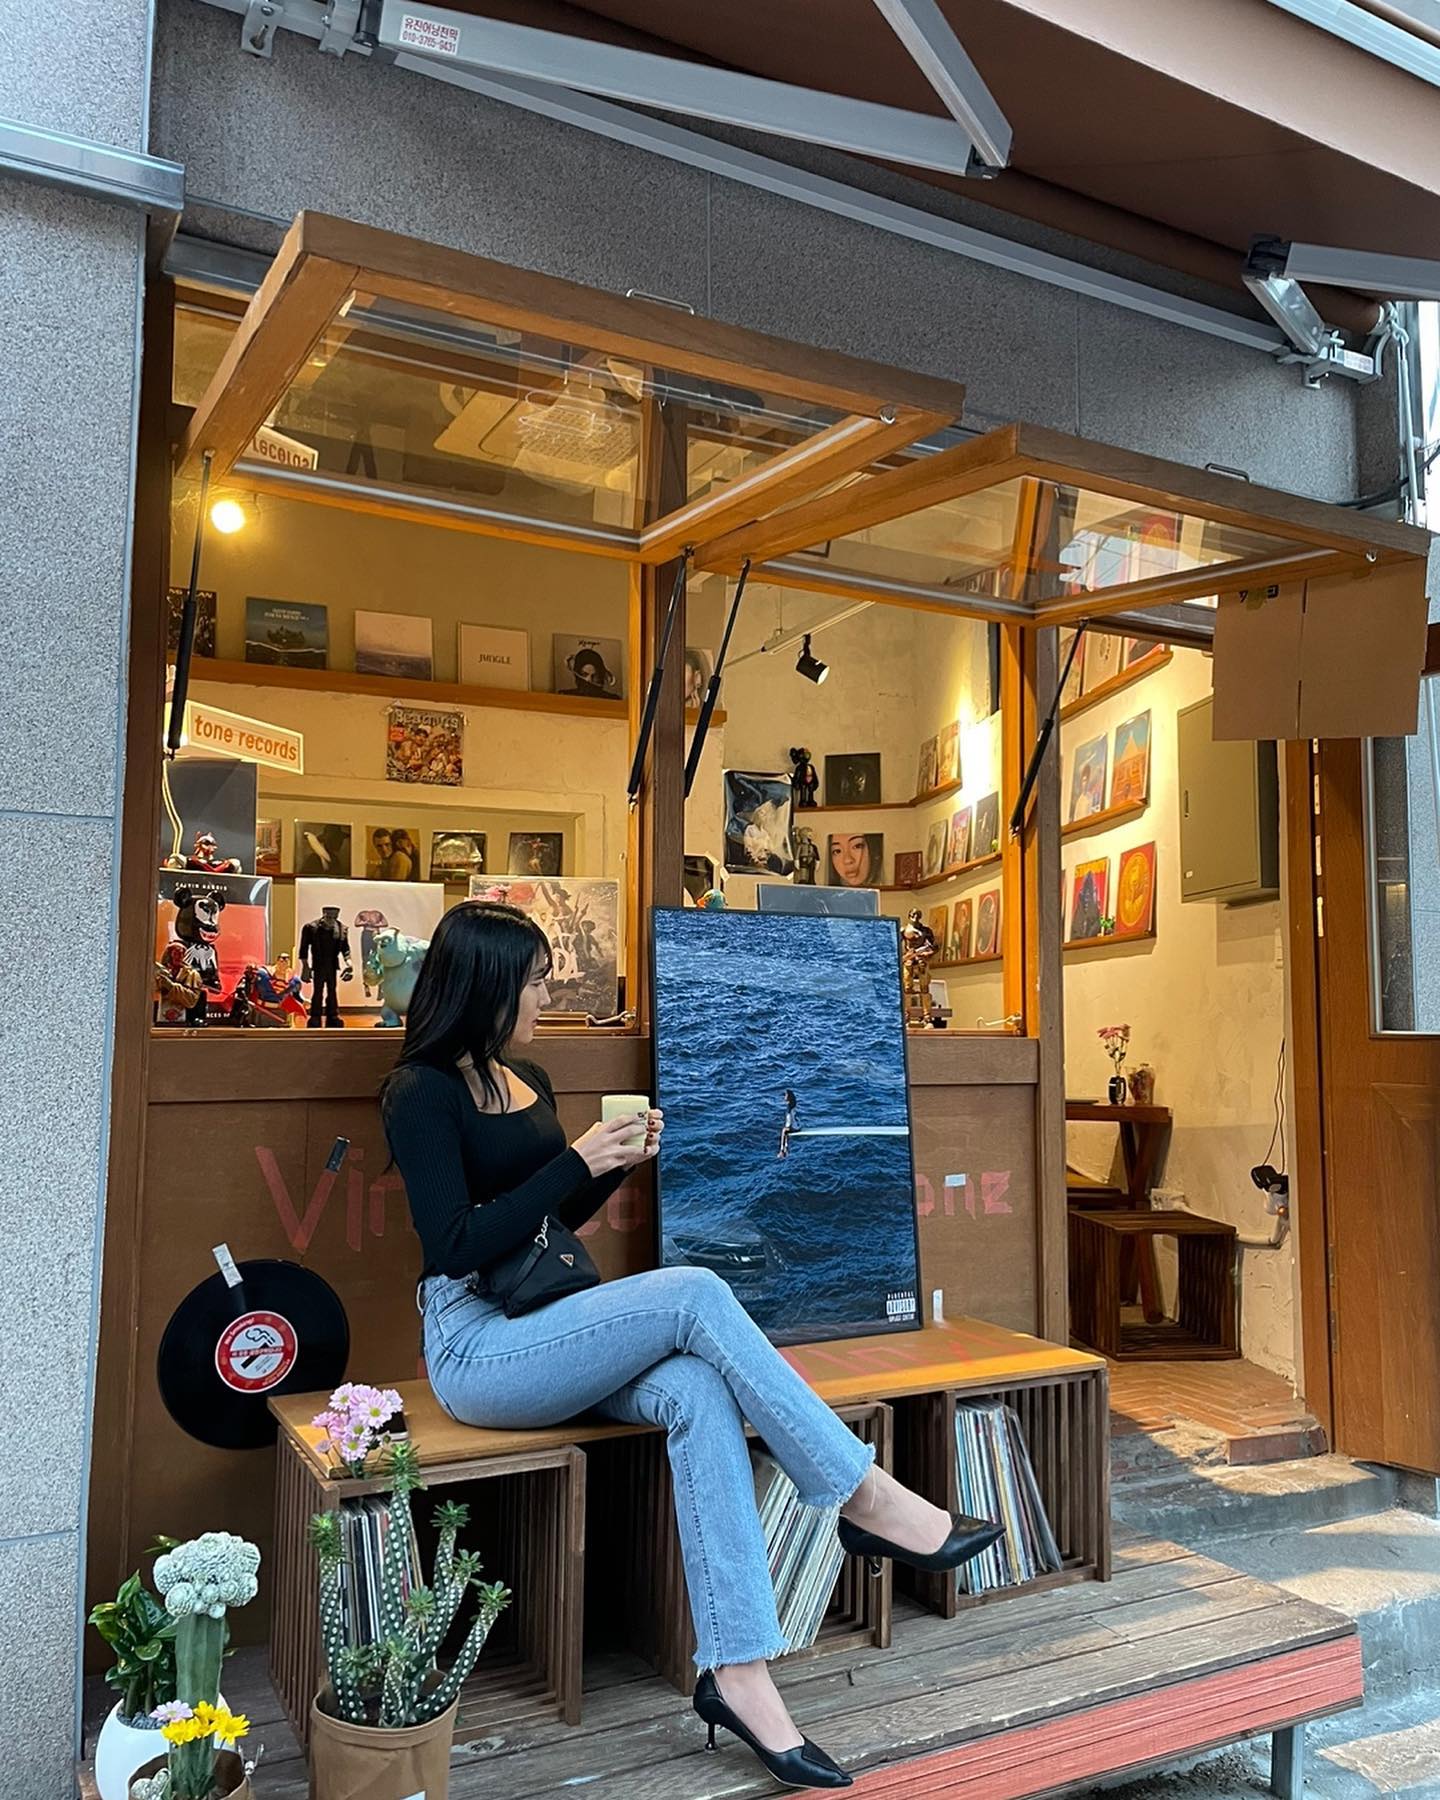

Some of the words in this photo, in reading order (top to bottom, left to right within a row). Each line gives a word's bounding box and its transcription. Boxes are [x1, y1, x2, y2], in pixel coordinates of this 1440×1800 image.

[478, 653, 512, 665] JUNGLE
[194, 714, 233, 744] tone
[238, 731, 297, 761] records
